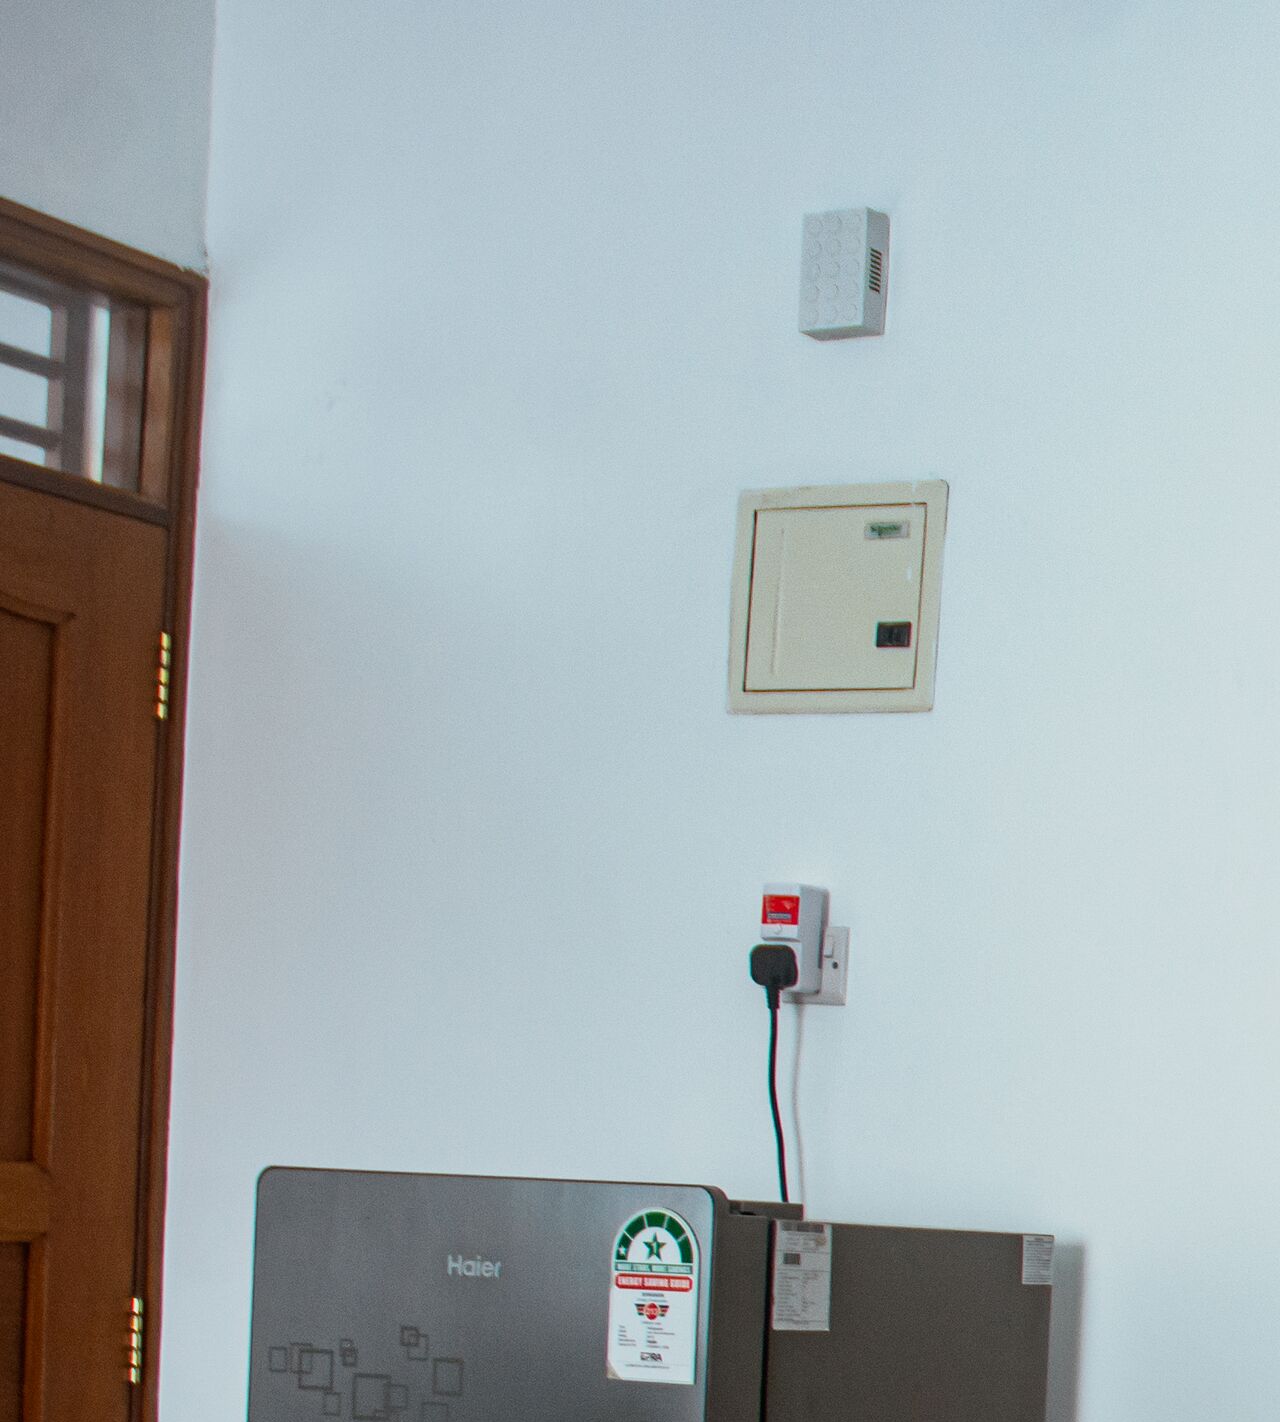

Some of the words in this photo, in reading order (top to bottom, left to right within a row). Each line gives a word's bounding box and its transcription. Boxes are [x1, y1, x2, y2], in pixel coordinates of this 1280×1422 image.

[447, 1255, 501, 1278] Haier
[617, 1275, 642, 1286] ENERGY
[644, 1277, 668, 1288] SAVING
[670, 1278, 690, 1289] GUIDE
